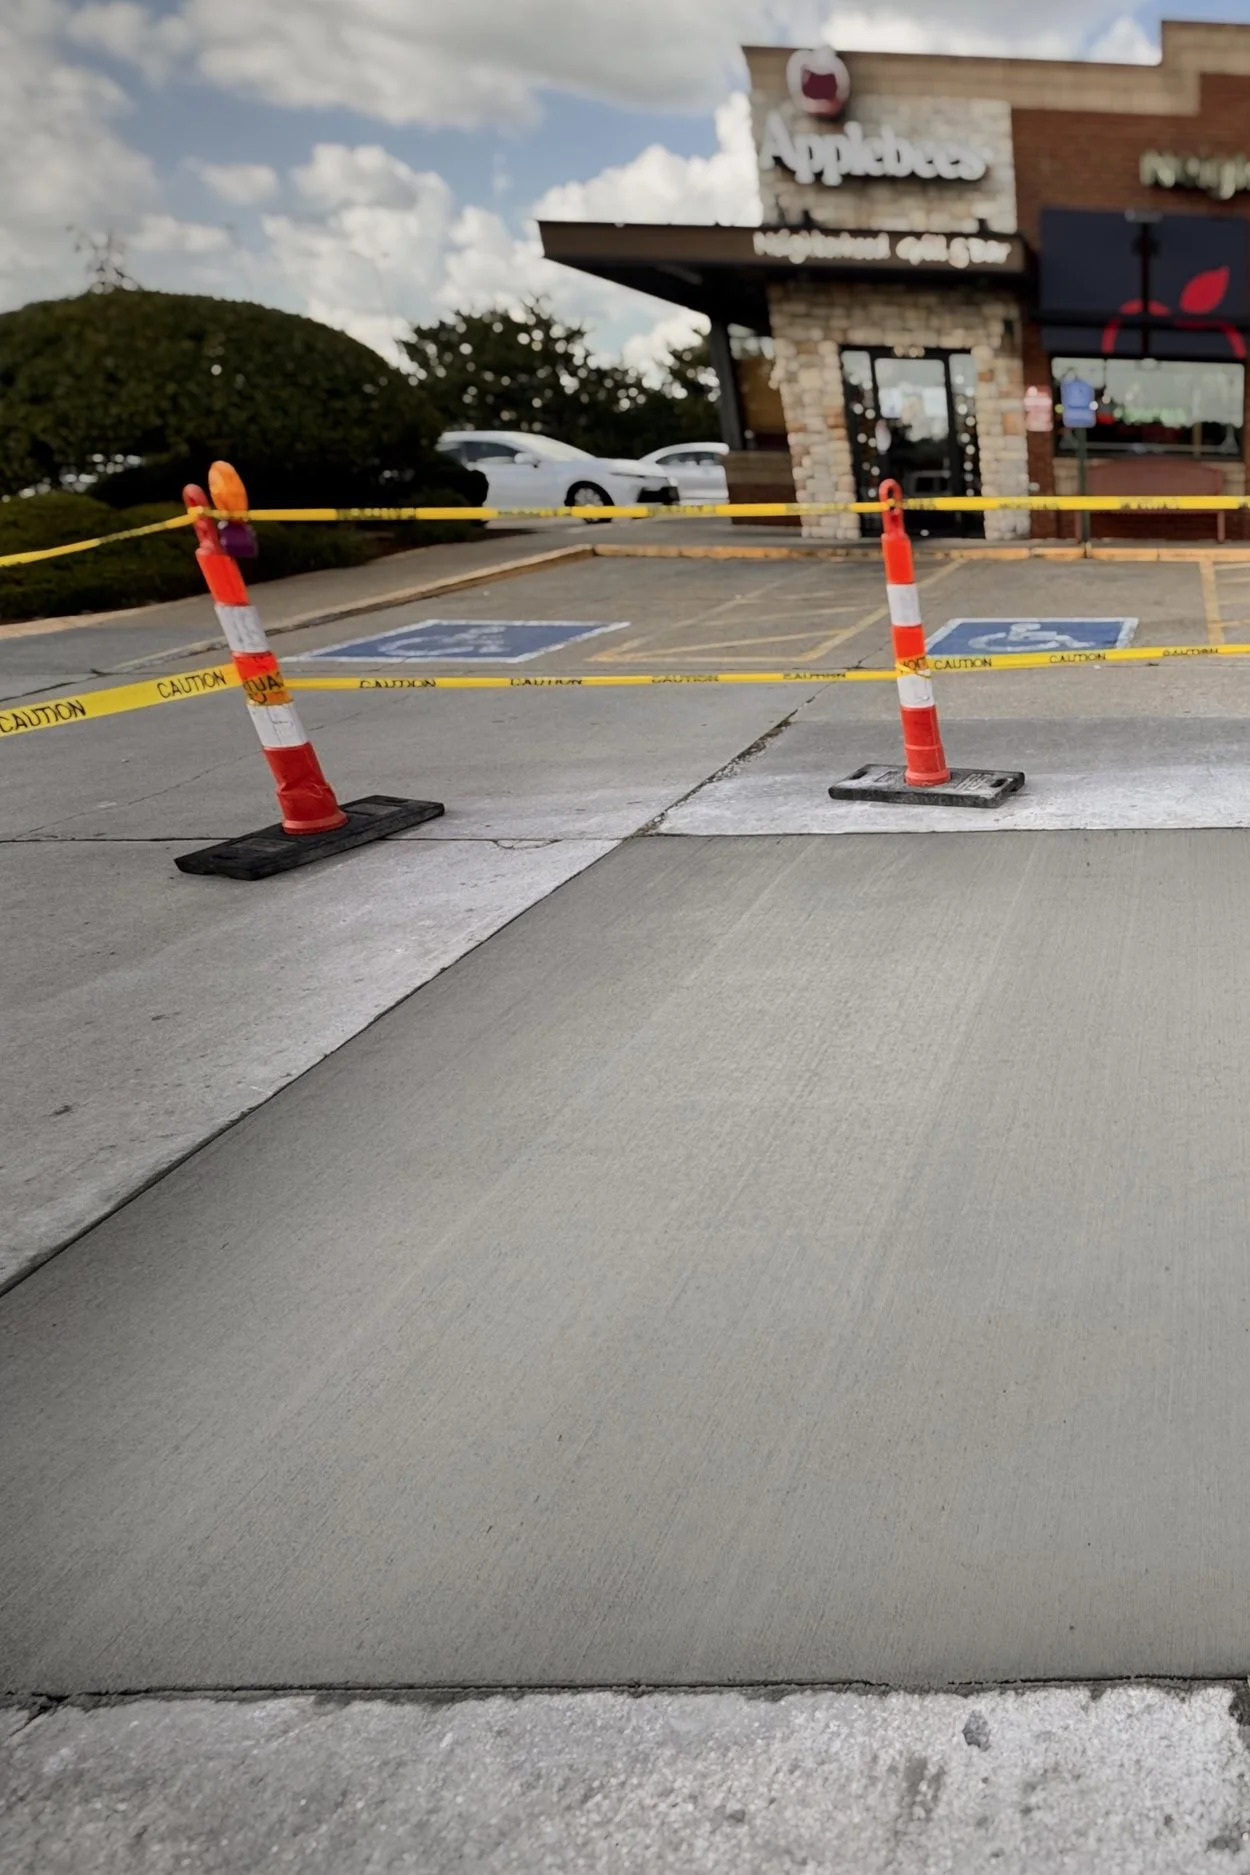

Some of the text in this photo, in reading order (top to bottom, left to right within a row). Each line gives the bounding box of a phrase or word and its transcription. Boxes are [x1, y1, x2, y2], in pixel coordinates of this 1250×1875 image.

[935, 657, 992, 671] CAUTION
[1050, 652, 1106, 664] CAUTION
[0, 700, 86, 734] CAUTION
[157, 671, 226, 699] CAUTION
